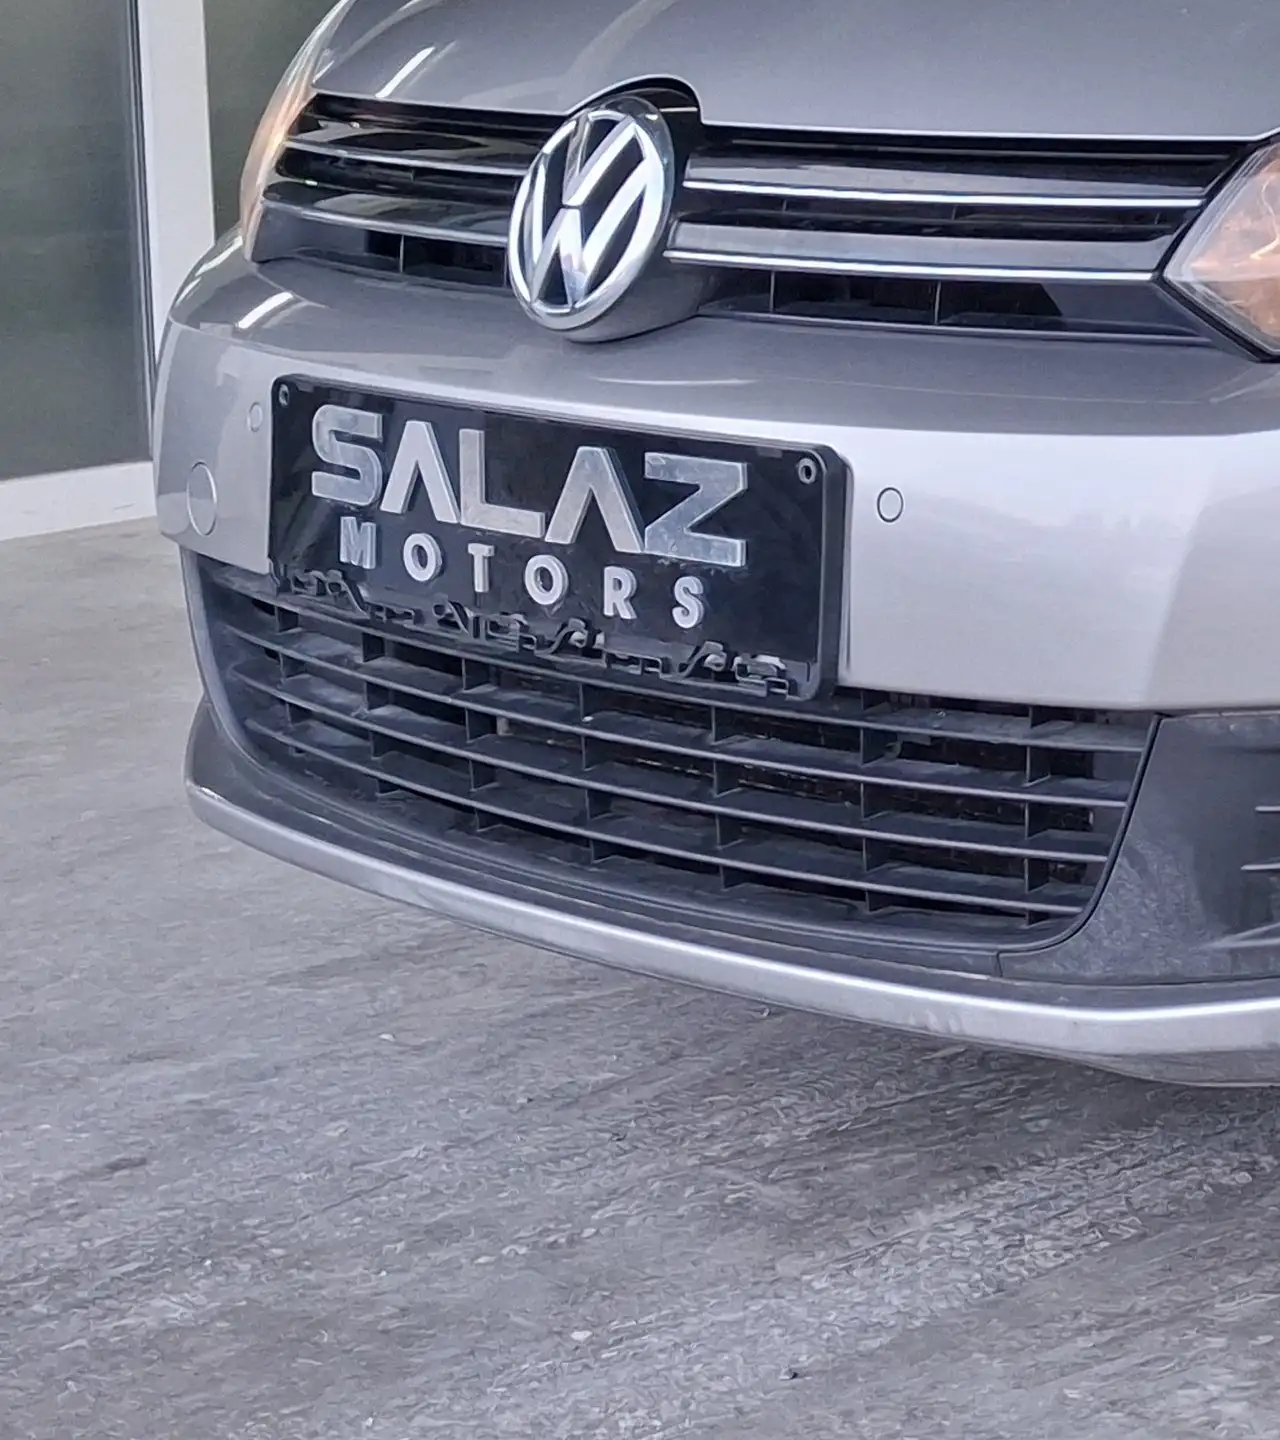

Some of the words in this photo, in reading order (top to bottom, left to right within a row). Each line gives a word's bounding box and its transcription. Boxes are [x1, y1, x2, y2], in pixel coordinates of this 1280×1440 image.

[509, 108, 666, 330] VW
[312, 404, 748, 567] SALAZ
[339, 515, 705, 629] MOTORS
